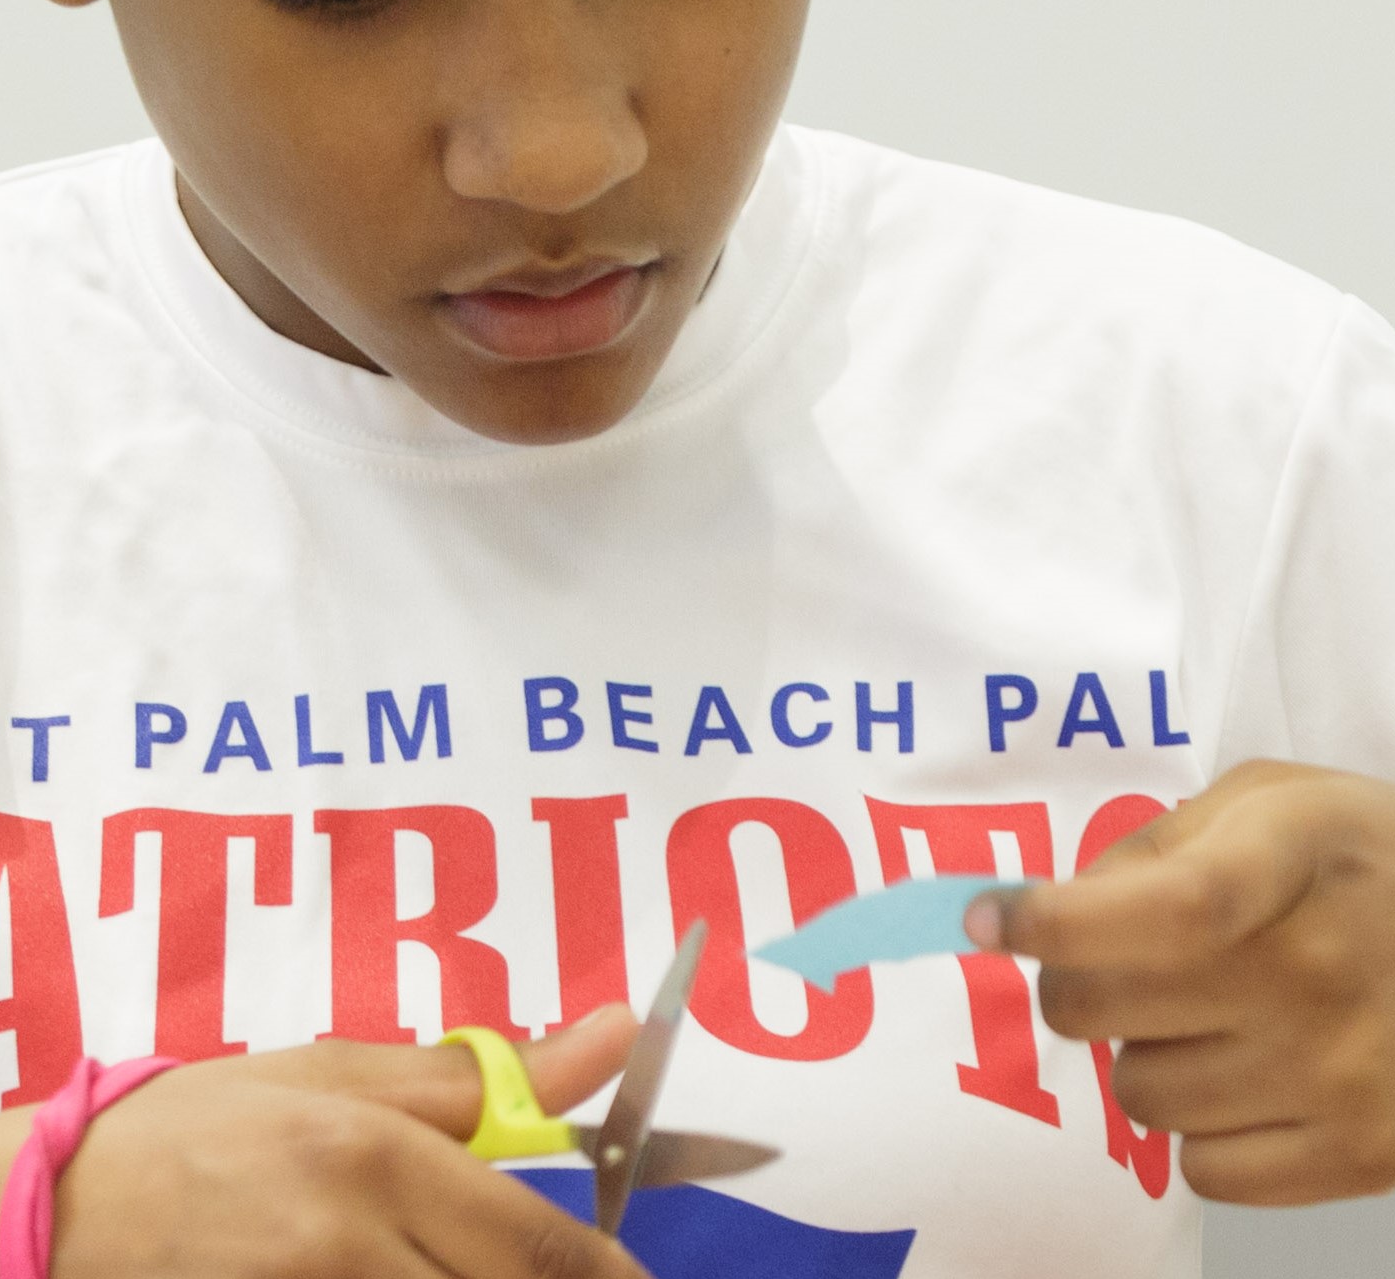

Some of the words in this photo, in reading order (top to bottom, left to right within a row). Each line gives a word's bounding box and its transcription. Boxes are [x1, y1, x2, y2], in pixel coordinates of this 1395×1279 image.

[135, 683, 453, 773] PALM
[522, 675, 915, 756] BEACH
[984, 669, 1192, 752] PAL
